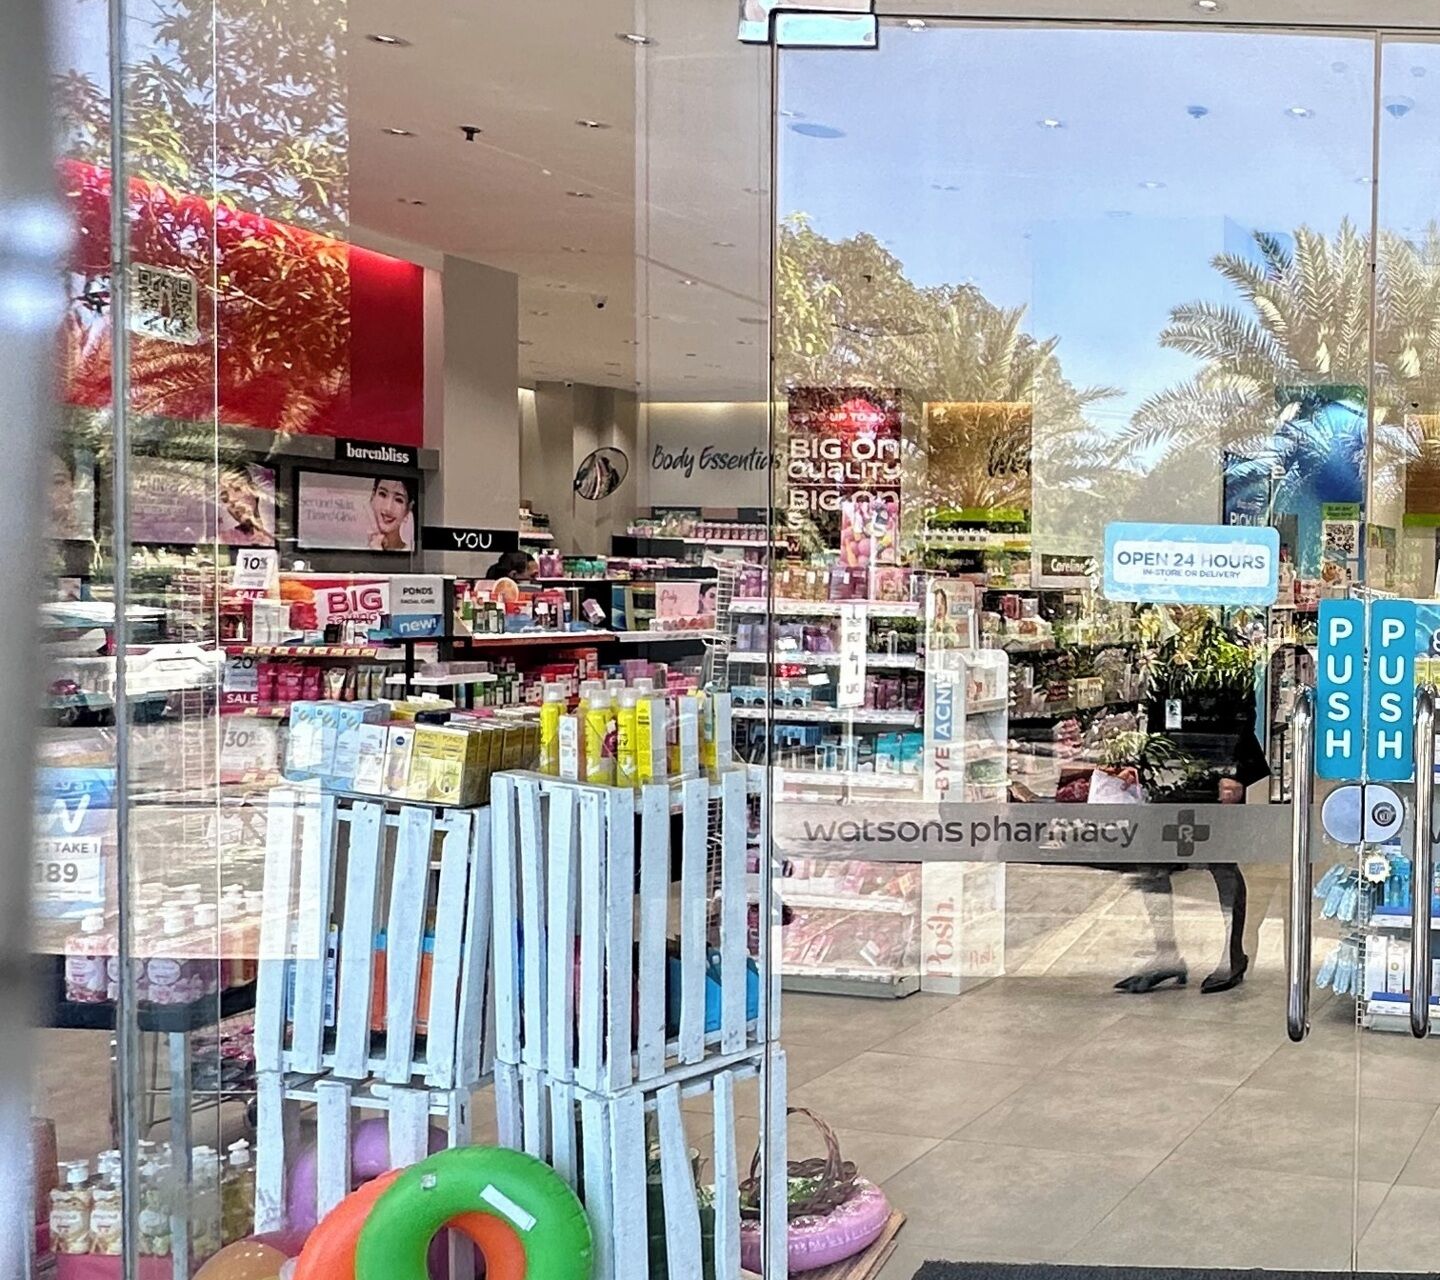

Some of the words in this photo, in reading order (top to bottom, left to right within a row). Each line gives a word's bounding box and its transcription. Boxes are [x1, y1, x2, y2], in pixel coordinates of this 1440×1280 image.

[652, 445, 694, 478] Body
[699, 445, 783, 471] Essentias
[453, 532, 492, 549] YOU
[1117, 551, 1169, 567] OPEN
[1174, 552, 1195, 567] 24
[1201, 554, 1266, 569] HOURS
[1143, 568, 1184, 577] IN-STORE
[1185, 569, 1197, 577] OR
[1199, 570, 1241, 579] DELIVERY
[327, 588, 384, 614] BIG
[399, 617, 437, 634] new!
[226, 693, 259, 704] SALE
[1326, 616, 1354, 759] PUSH
[1376, 617, 1406, 760] PUSH
[803, 818, 963, 844] watsons
[969, 815, 1139, 849] pharmacy
